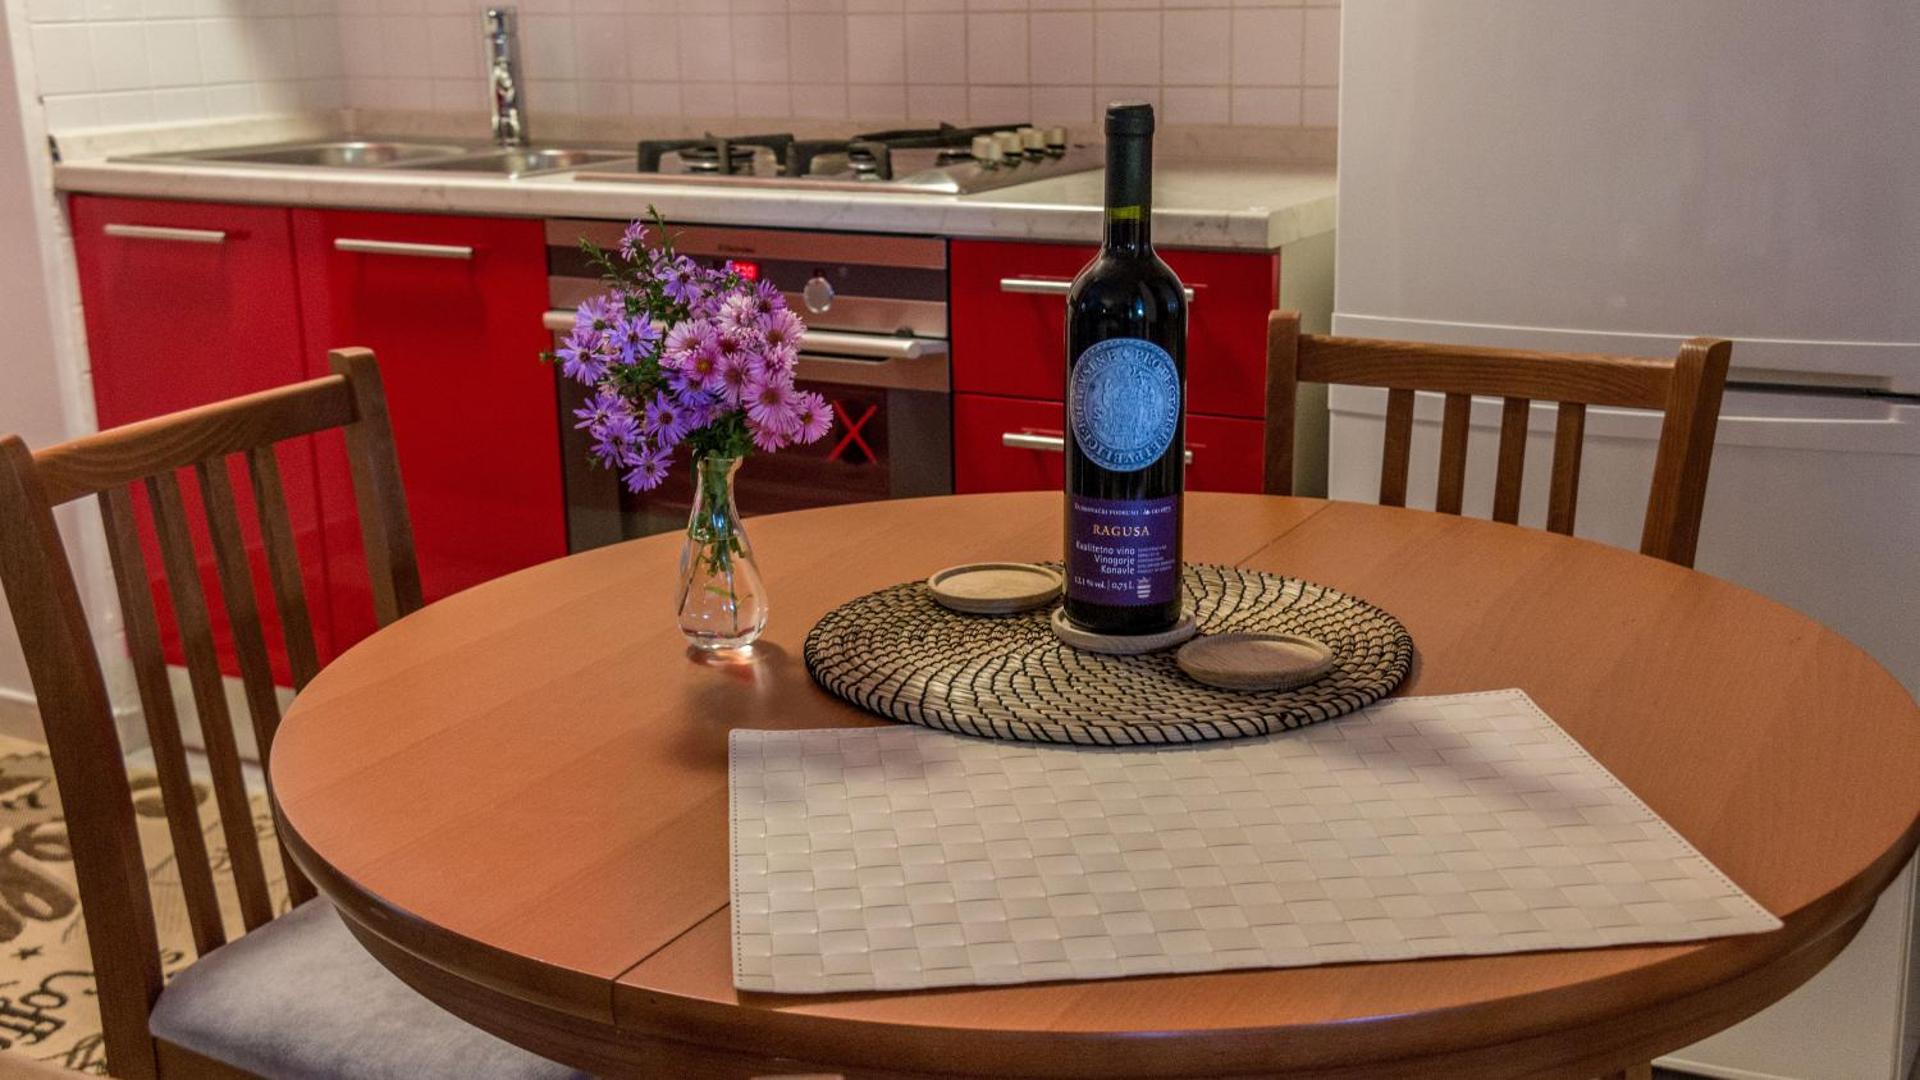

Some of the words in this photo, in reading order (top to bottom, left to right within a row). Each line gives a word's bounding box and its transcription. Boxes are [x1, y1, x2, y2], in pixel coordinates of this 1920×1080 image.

[1093, 524, 1149, 537] RAGUSA
[1076, 541, 1114, 555] Kvalitetno
[1117, 546, 1135, 555] vino
[1094, 555, 1135, 567] Vinogorje
[1101, 566, 1135, 575] Konavle
